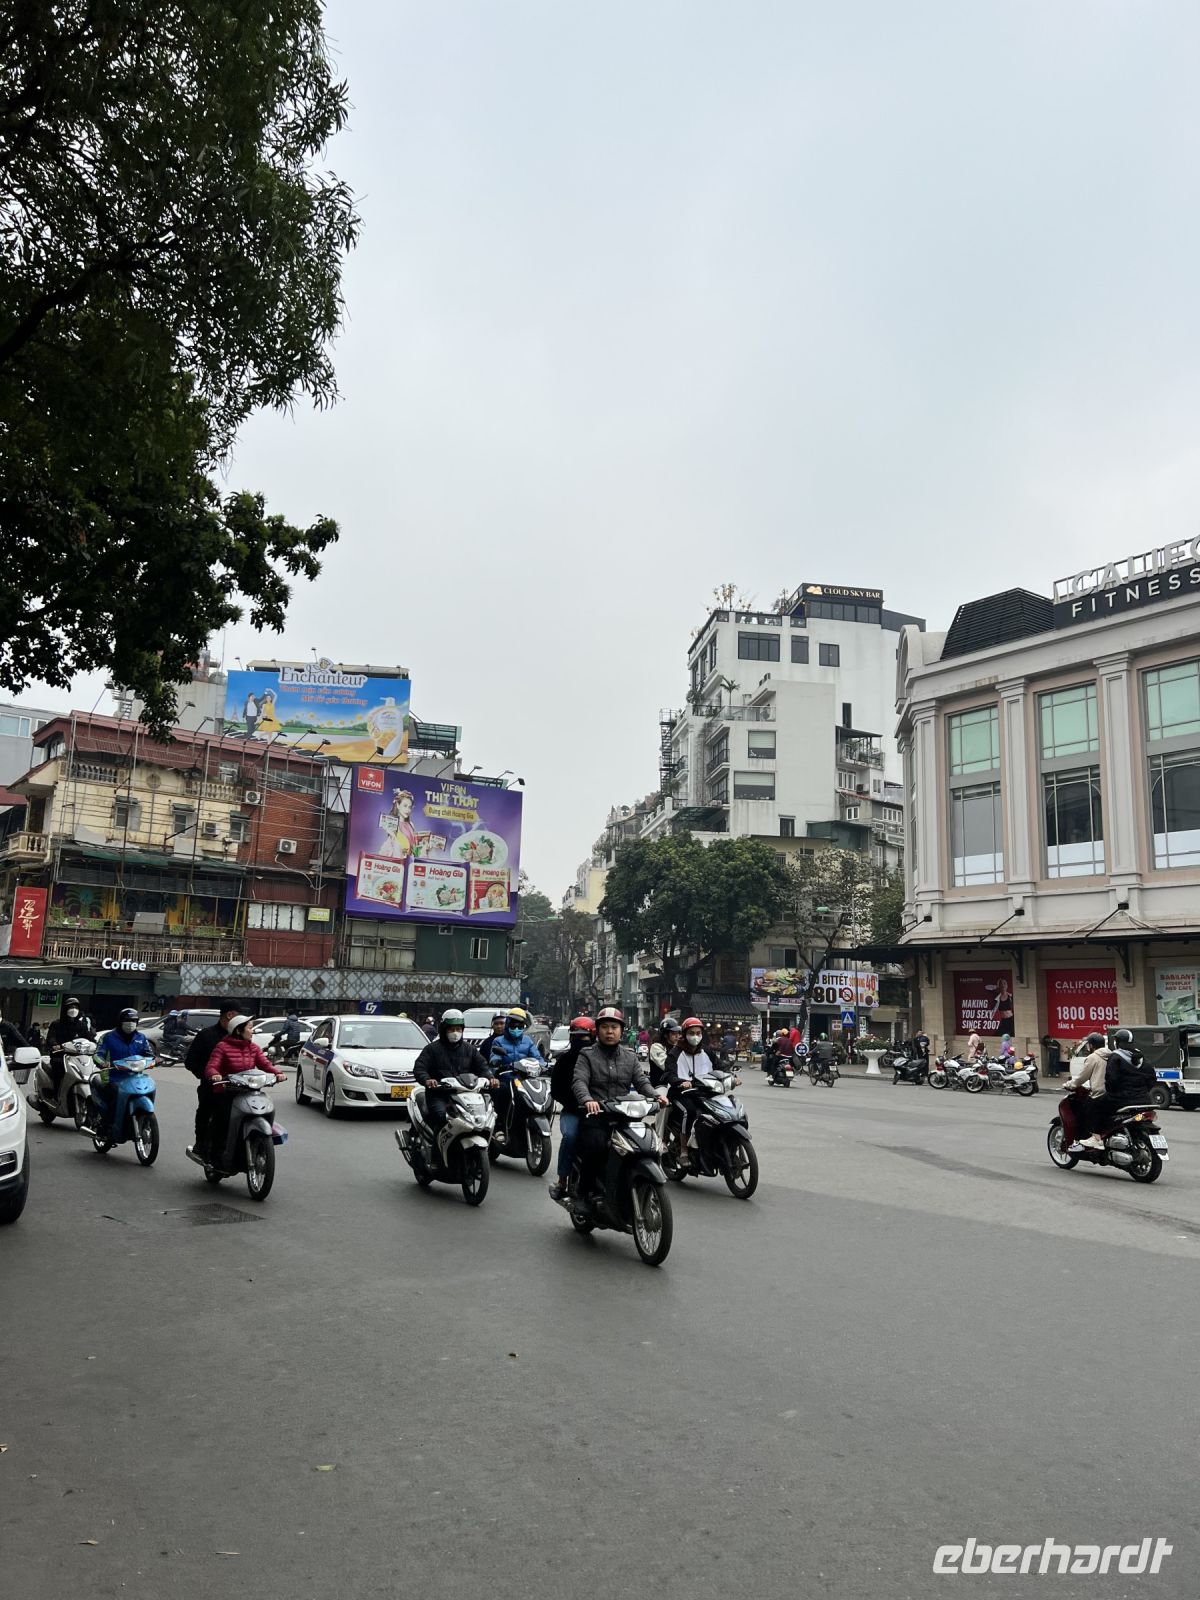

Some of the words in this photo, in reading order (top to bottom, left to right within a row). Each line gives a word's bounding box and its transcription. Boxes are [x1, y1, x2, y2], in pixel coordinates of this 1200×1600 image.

[823, 587, 849, 596] CLOUD
[866, 591, 881, 599] BAR
[1072, 567, 1200, 618] FITNESS
[280, 666, 367, 686] Enchanteur
[361, 779, 382, 788] VIFON
[441, 782, 467, 795] VIFON
[429, 867, 451, 878] Hoàng
[452, 869, 464, 878] Gia
[102, 957, 147, 971] Coffee
[27, 977, 53, 986] Coffee
[53, 978, 63, 986] 26
[1055, 980, 1117, 989] CALIFORNIA
[365, 1002, 378, 1013] G7
[961, 999, 988, 1009] MAKING
[961, 1009, 975, 1019] YOU
[977, 1009, 994, 1020] SEXY
[1056, 1006, 1085, 1021] 1800
[1090, 1006, 1119, 1021] 6995
[961, 1020, 981, 1029] SINCE
[982, 1020, 1000, 1030] 2007
